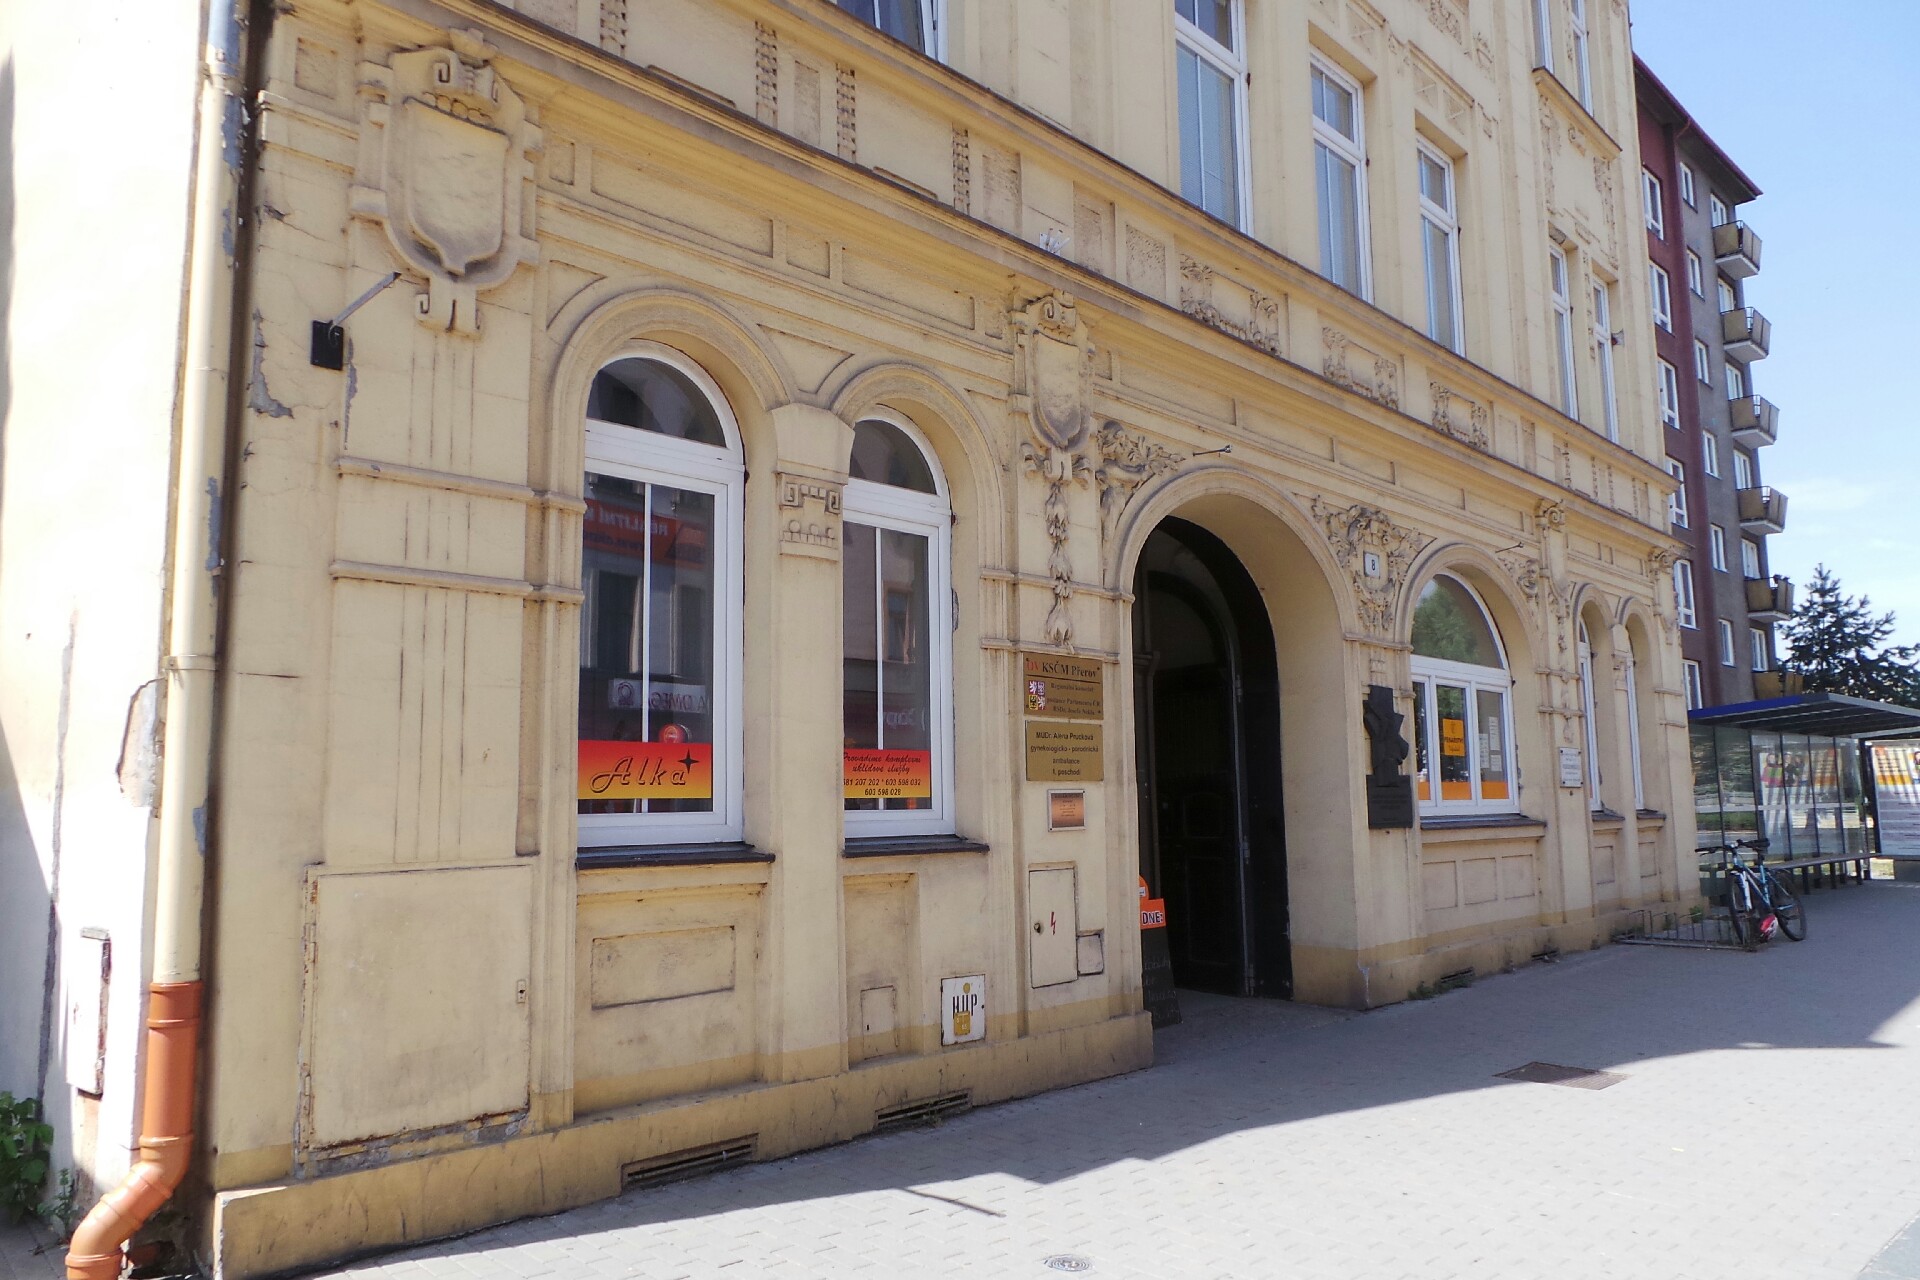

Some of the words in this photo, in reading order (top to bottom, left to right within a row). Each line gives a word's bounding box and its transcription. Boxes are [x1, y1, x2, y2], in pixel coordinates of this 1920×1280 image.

[1371, 559, 1376, 571] 8
[1042, 661, 1069, 676] KSČM
[1071, 665, 1096, 678] Přerov
[590, 756, 687, 794] Alka
[855, 778, 867, 786] 207
[868, 778, 880, 786] 202
[885, 778, 897, 786] 603
[864, 788, 876, 796] 603
